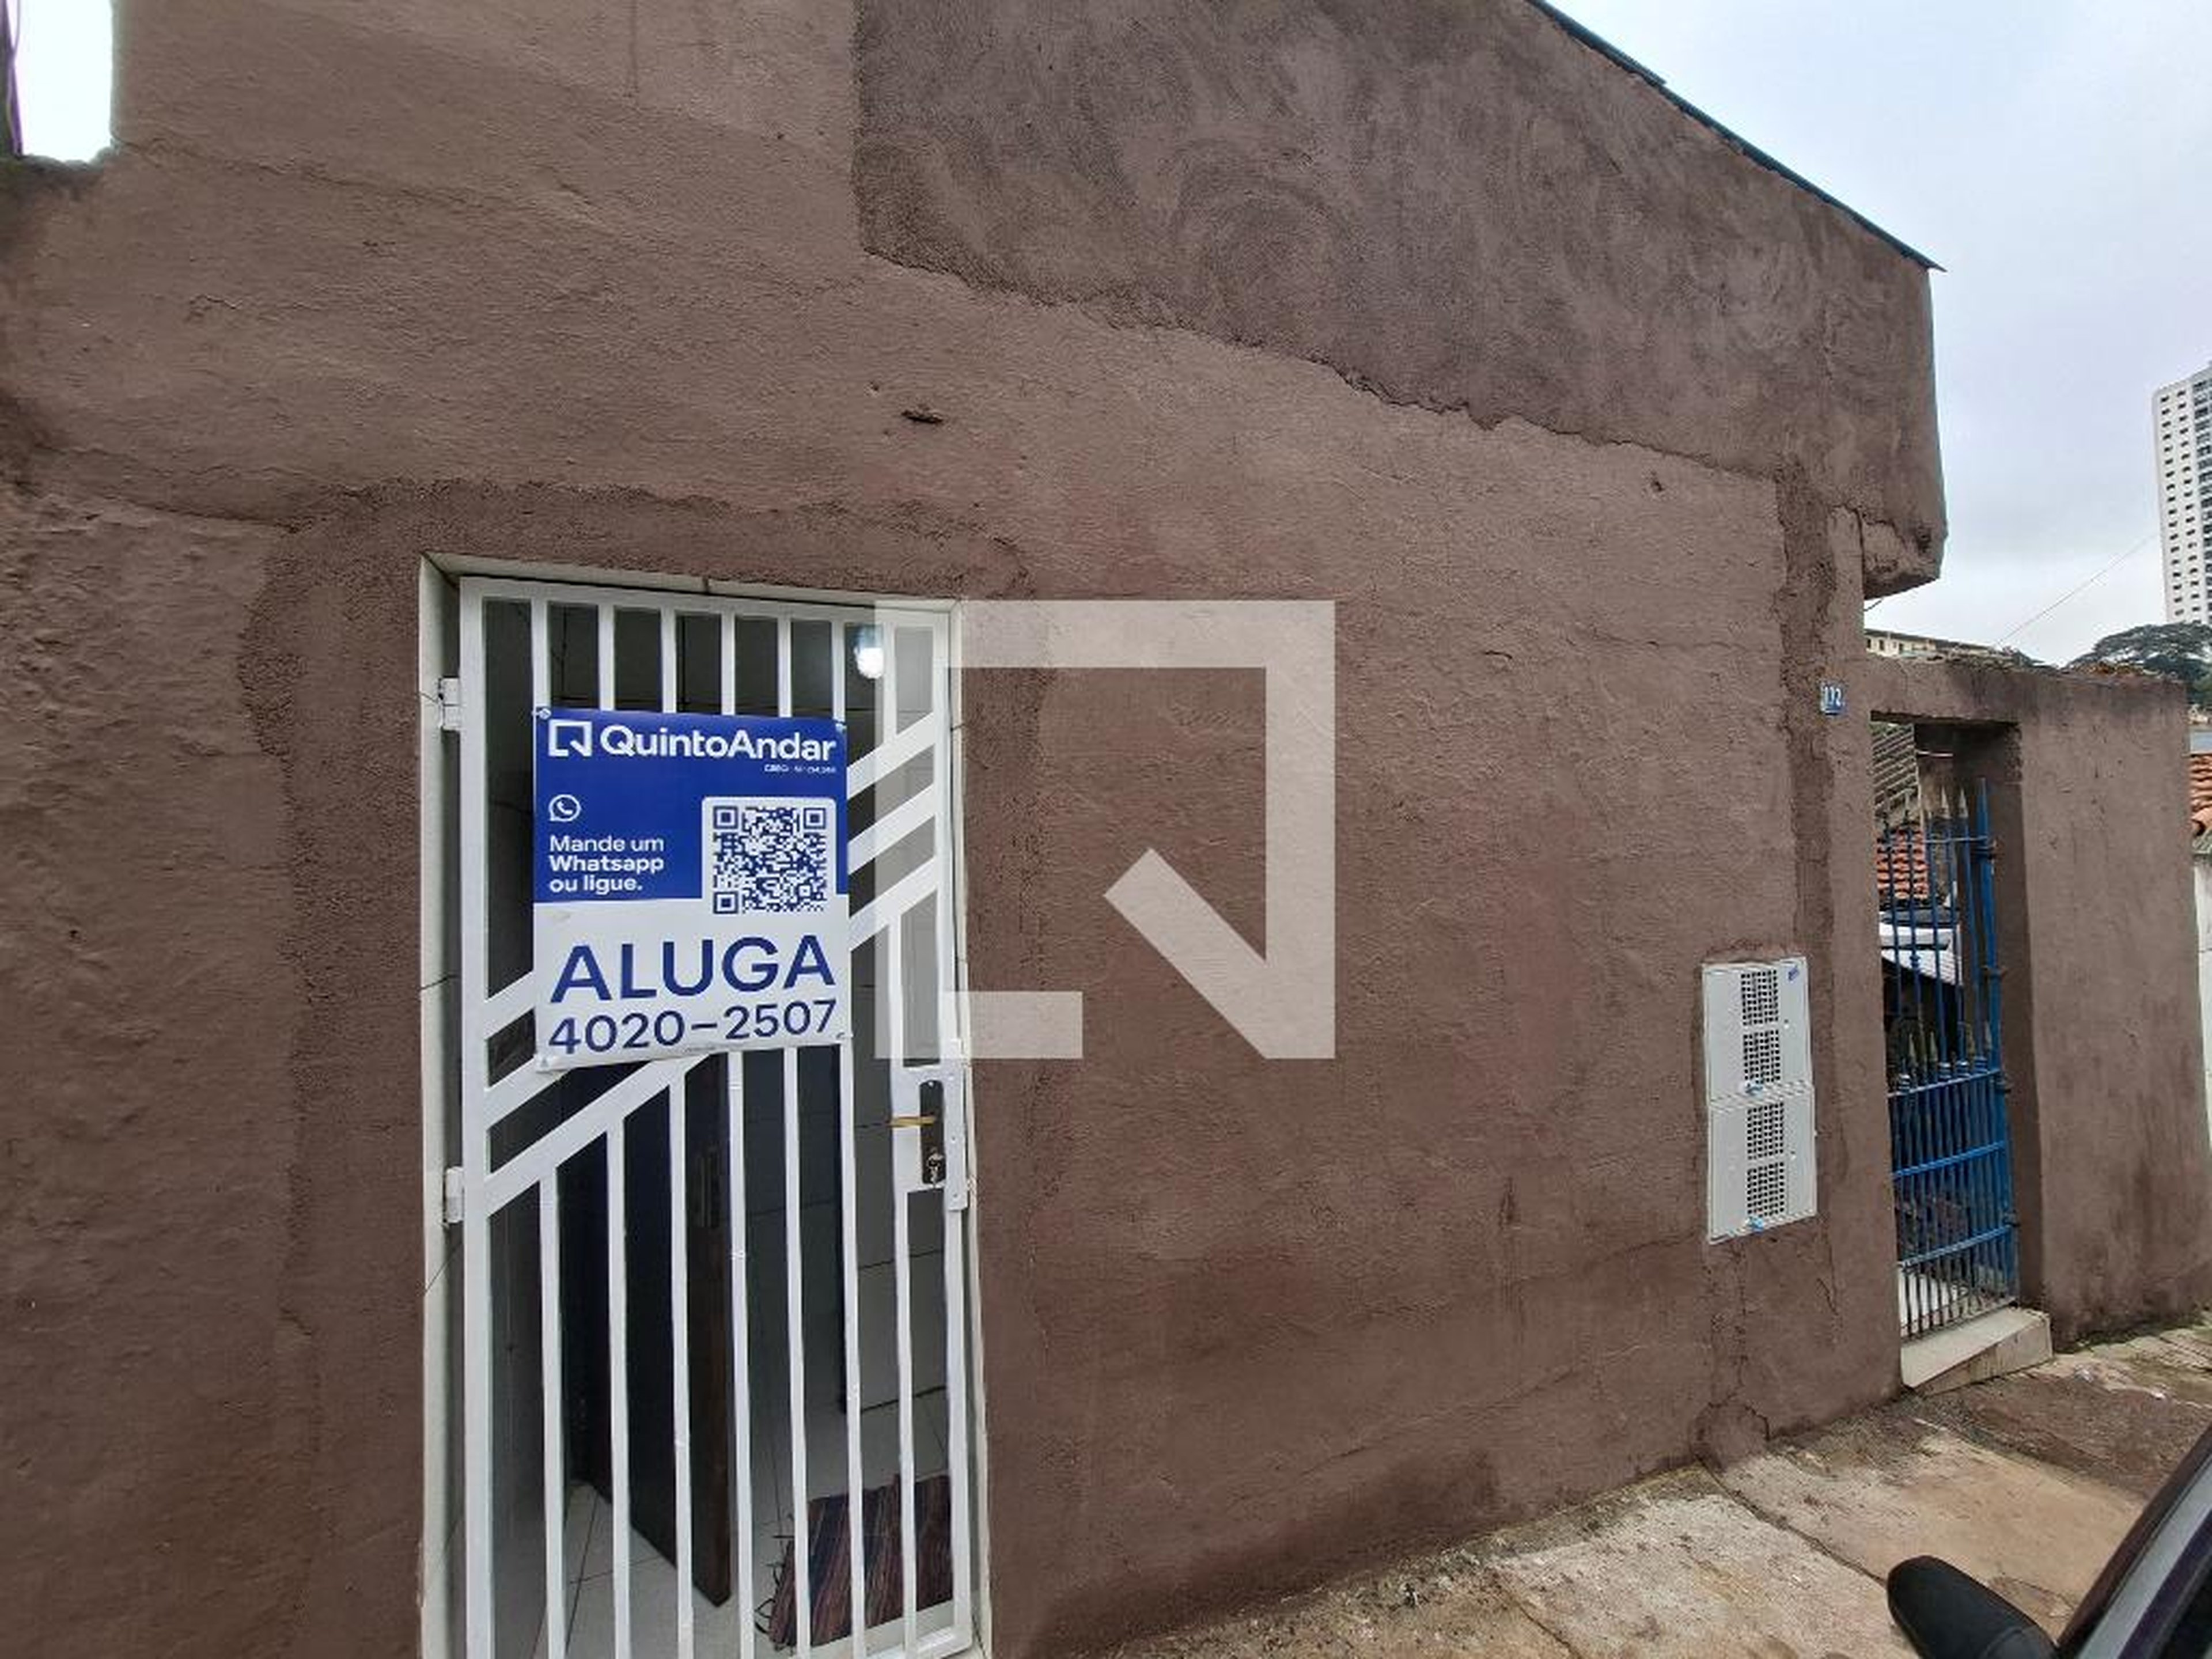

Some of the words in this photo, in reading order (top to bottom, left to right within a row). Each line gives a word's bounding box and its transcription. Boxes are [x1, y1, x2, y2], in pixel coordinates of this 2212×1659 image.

[600, 724, 836, 761] QuintoAndar
[550, 835, 626, 852] Mande
[631, 838, 664, 852] um
[549, 854, 664, 875] Whatsapp
[550, 878, 578, 893] ou
[584, 874, 643, 895] ligue.
[550, 934, 836, 1003] ALUGA
[548, 998, 837, 1055] 4020-2507
